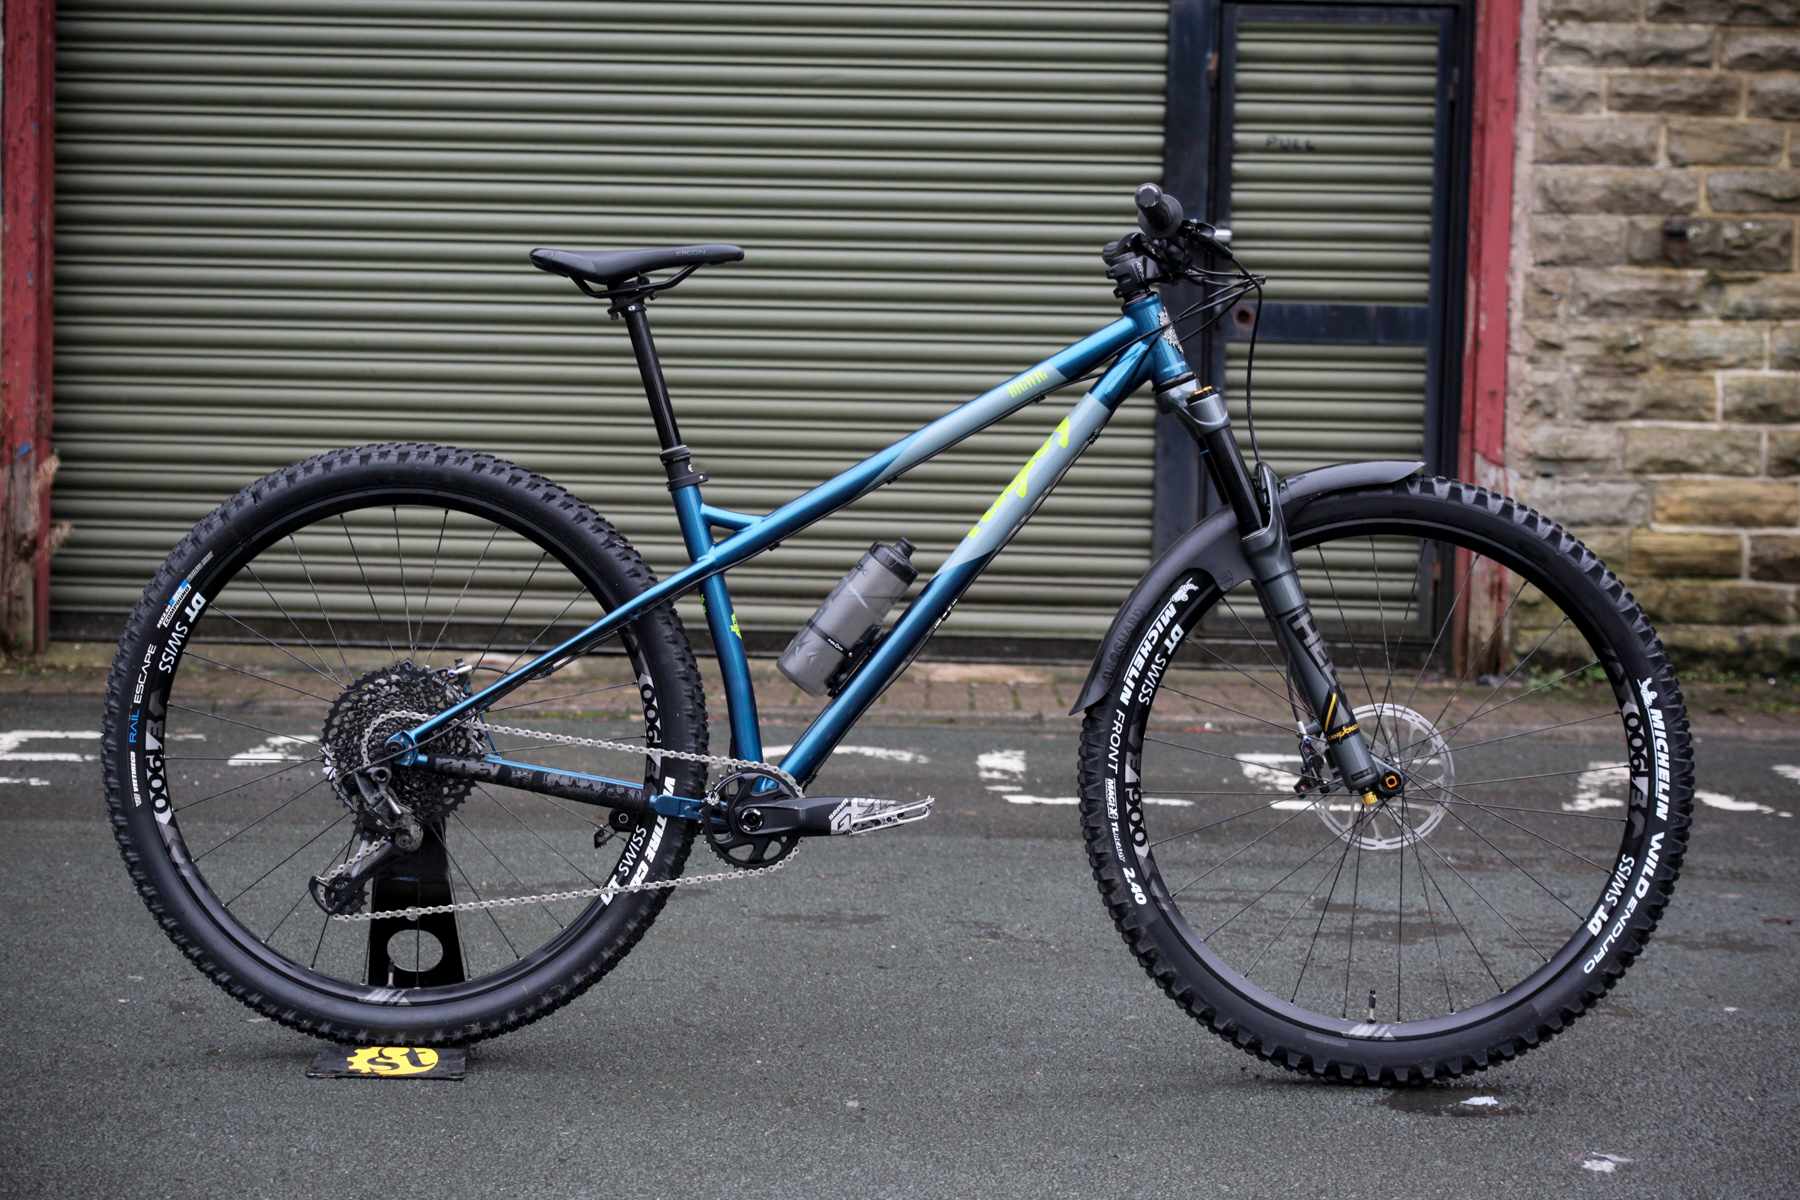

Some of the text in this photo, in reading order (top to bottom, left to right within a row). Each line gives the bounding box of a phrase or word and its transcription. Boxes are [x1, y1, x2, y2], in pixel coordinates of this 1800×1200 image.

[184, 592, 206, 623] DT
[133, 643, 157, 704] ESCAPE
[158, 621, 188, 673] SWISS
[1119, 603, 1177, 706] MICHELIN
[1138, 623, 1185, 706] DT SWISS
[128, 709, 140, 743] RAIL
[1107, 709, 1125, 774] FRONT
[618, 824, 647, 877] SWISS
[644, 815, 667, 863] TIRE
[1583, 708, 1671, 974] MICHELIN WILD ENDURO
[1122, 867, 1147, 905] 2.40
[1587, 853, 1635, 937] DT SWISS
